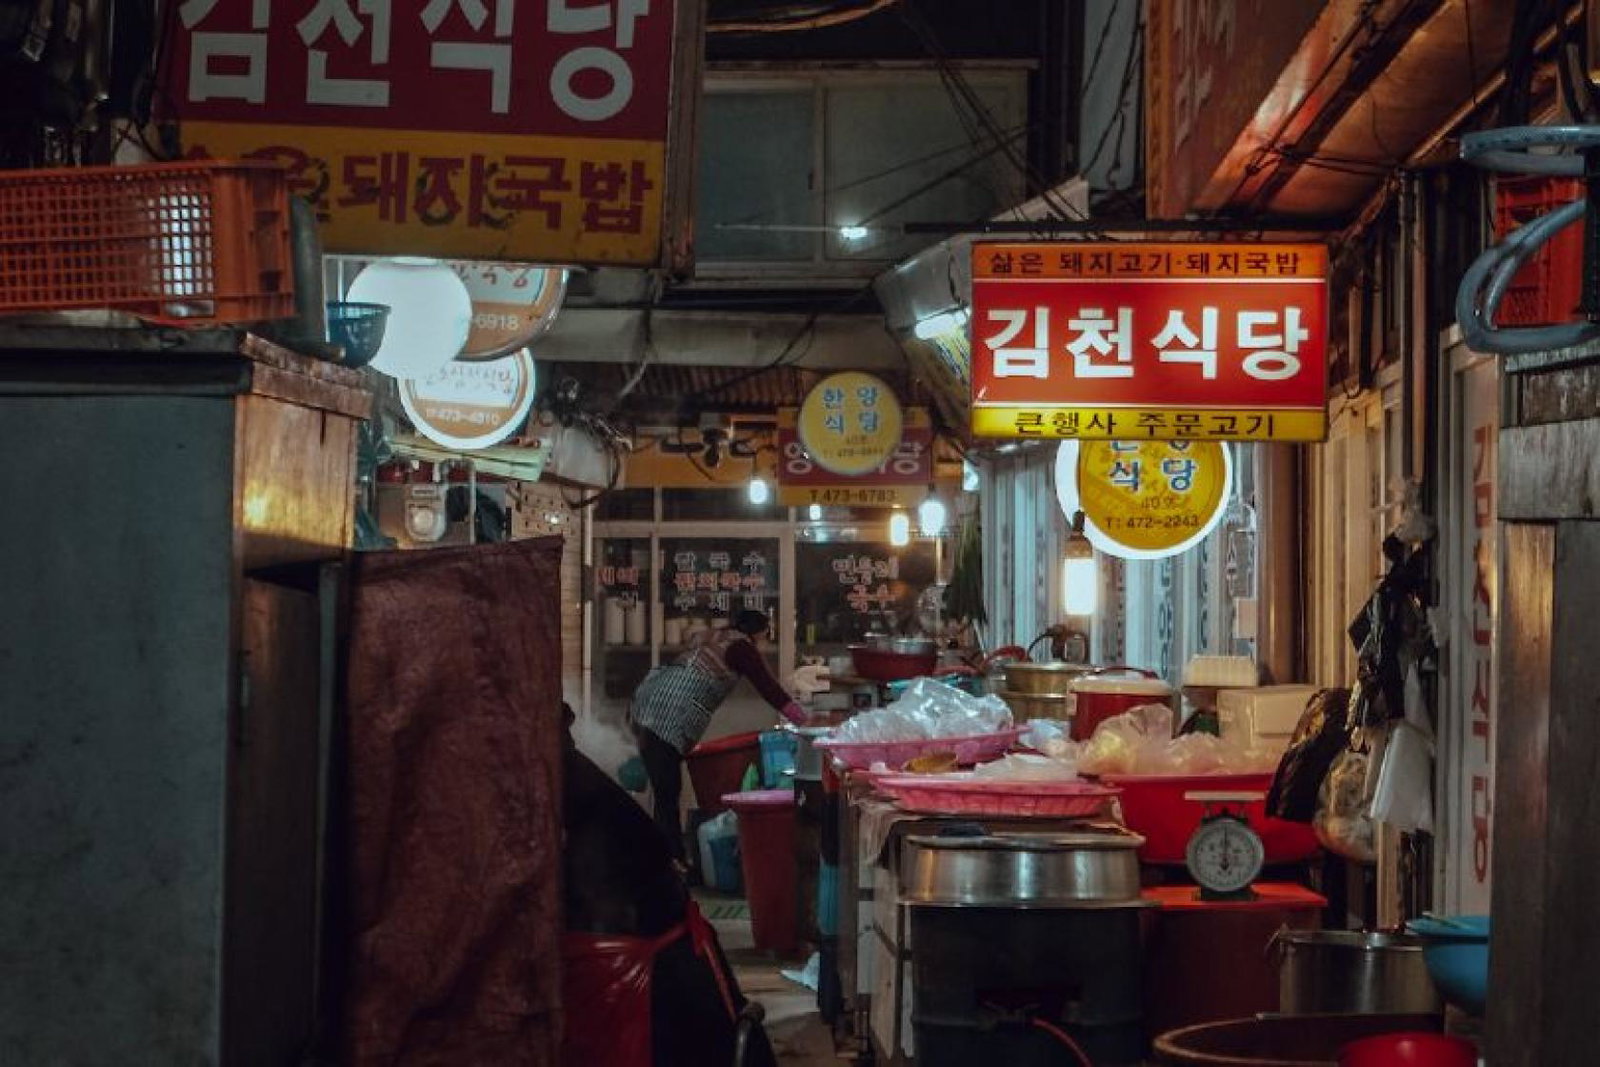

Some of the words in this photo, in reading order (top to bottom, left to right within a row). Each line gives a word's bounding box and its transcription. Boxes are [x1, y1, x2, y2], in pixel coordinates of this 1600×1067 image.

[989, 251, 1045, 274] 삶은
[984, 305, 1310, 380] 김천식당
[1014, 411, 1117, 437] 큰행사
[1135, 413, 1275, 438] 주문고기
[1109, 458, 1198, 492] 식당
